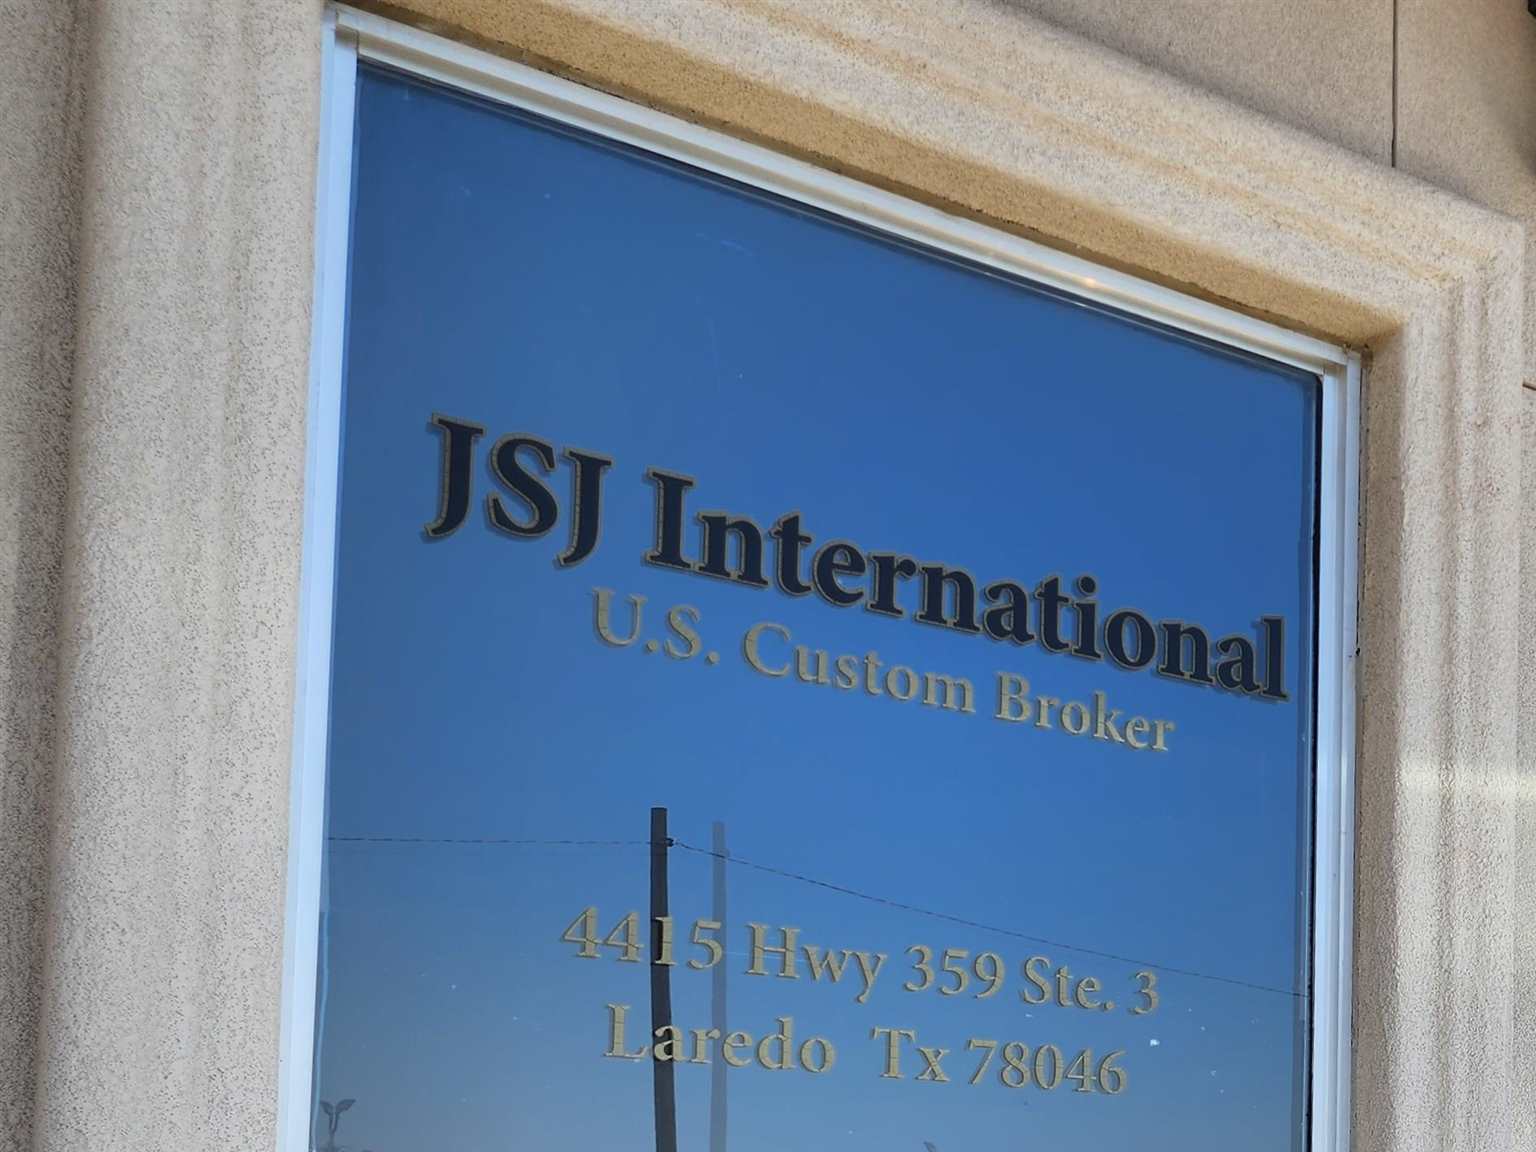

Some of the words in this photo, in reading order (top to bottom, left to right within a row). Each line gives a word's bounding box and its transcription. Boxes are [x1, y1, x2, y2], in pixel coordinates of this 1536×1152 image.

[420, 411, 613, 568] JSJ
[641, 465, 1290, 702] International
[591, 587, 720, 665] U.S.
[742, 621, 977, 716] Custom
[995, 669, 1175, 753] Broker
[562, 906, 724, 970] 4415
[746, 922, 887, 1005] Hwy
[903, 943, 1005, 999] 359
[1020, 955, 1115, 1013] Ste.
[1128, 969, 1160, 1016] 3
[603, 1002, 837, 1075] Laredo
[870, 1025, 952, 1083] Tx
[966, 1037, 1129, 1096] 78046
